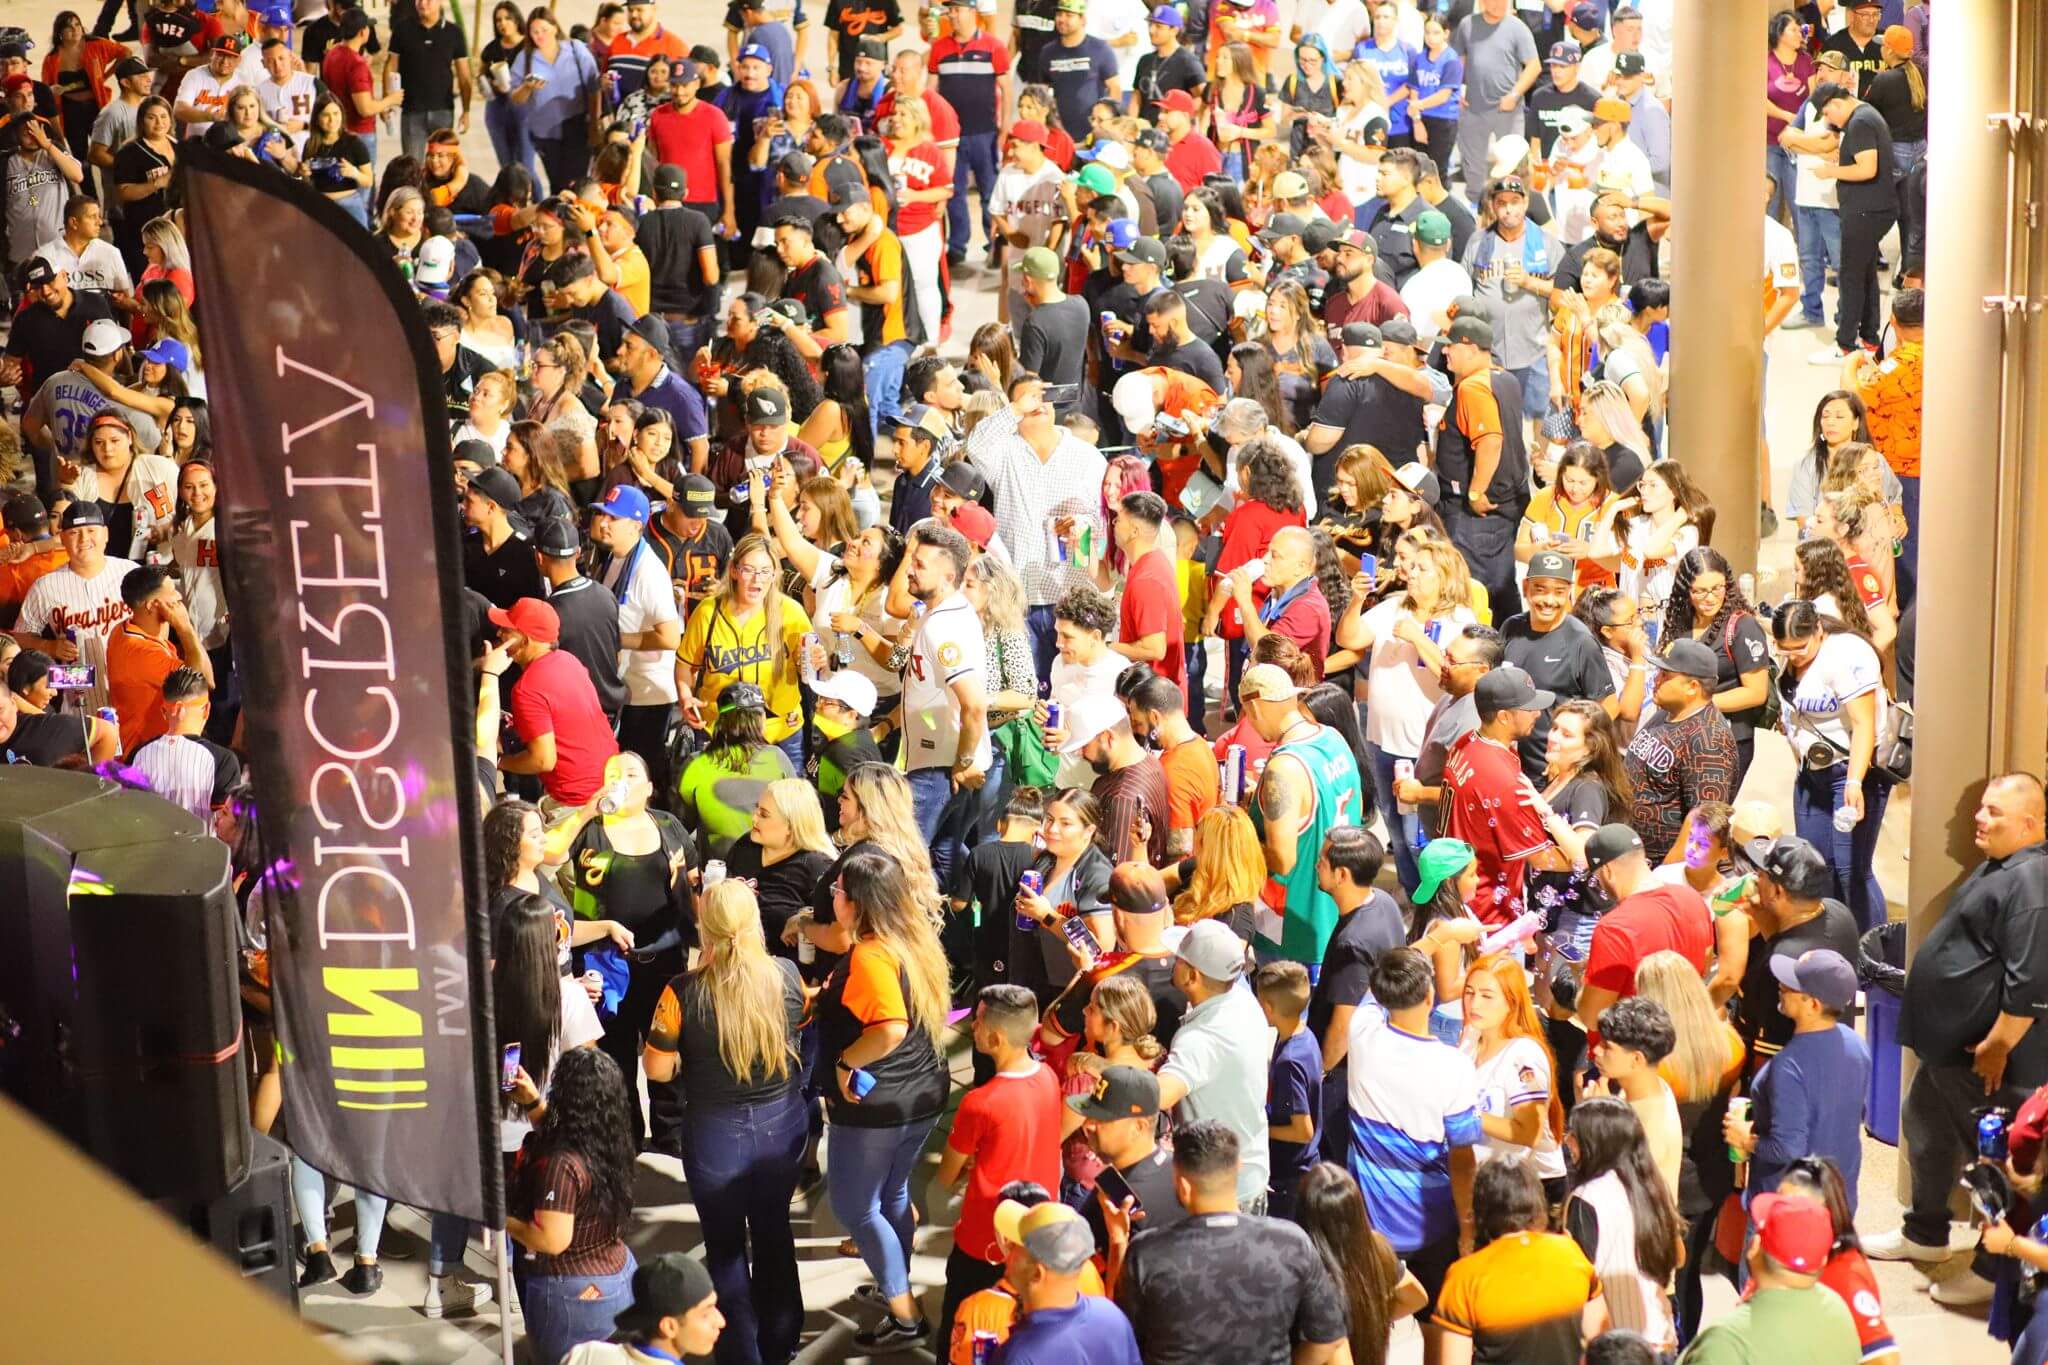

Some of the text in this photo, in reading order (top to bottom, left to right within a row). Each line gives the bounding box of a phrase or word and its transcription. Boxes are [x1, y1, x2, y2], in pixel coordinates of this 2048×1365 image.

[155, 23, 184, 38] PEZ
[291, 94, 311, 116] H
[55, 384, 107, 411] BELLINGE
[144, 482, 174, 520] H
[197, 539, 218, 567] H
[692, 553, 716, 585] H
